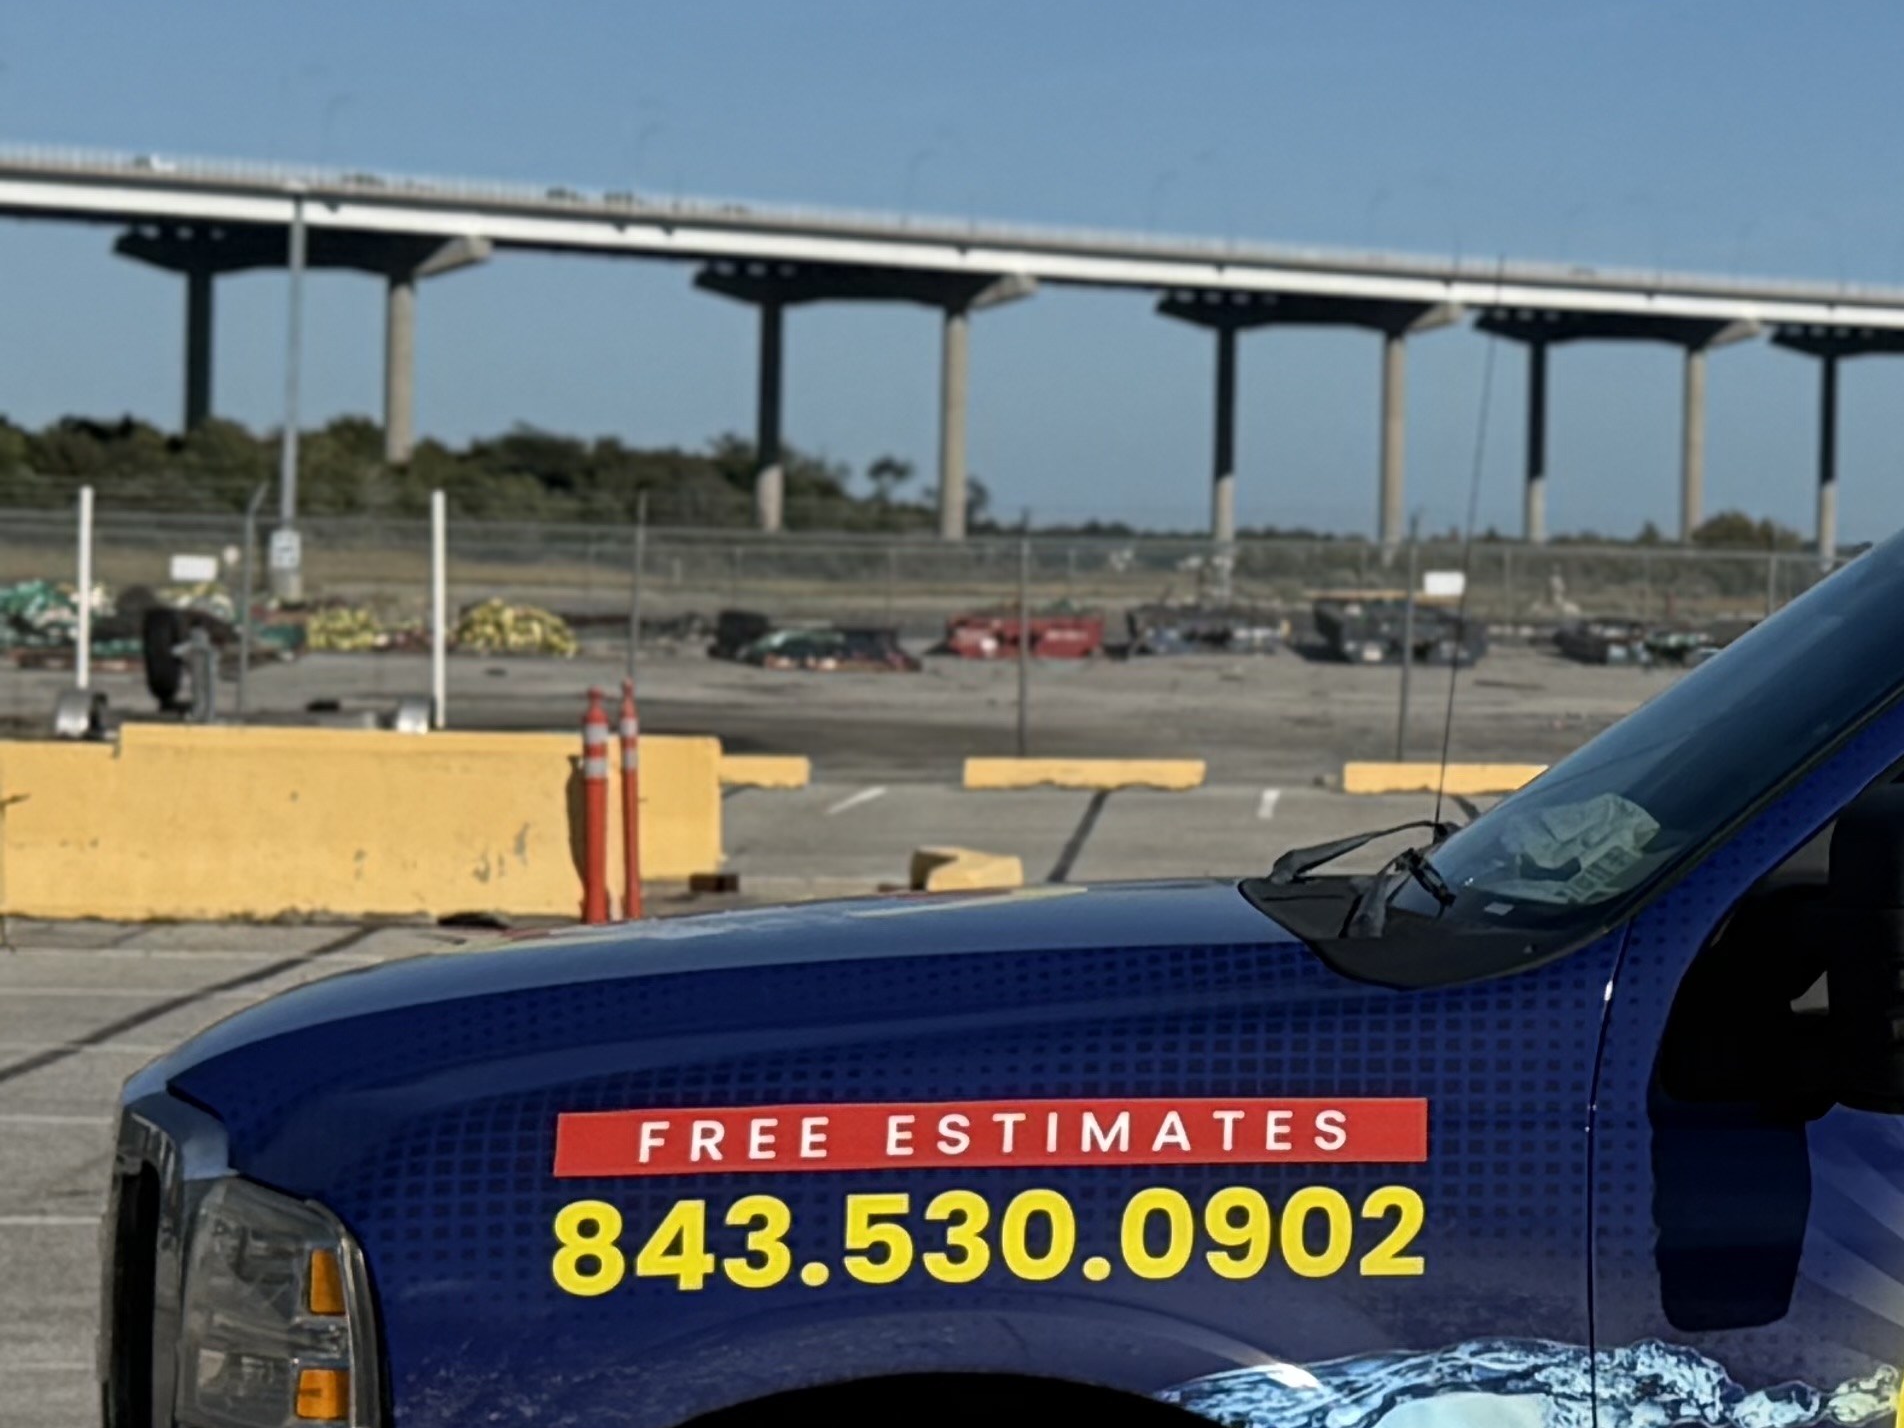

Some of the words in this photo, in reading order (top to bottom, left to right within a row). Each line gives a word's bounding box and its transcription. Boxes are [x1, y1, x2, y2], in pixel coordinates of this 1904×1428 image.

[637, 1114, 829, 1165] FREE
[885, 1109, 1349, 1157] ESTIMATES
[550, 1185, 1426, 1297] 843.530.0902
